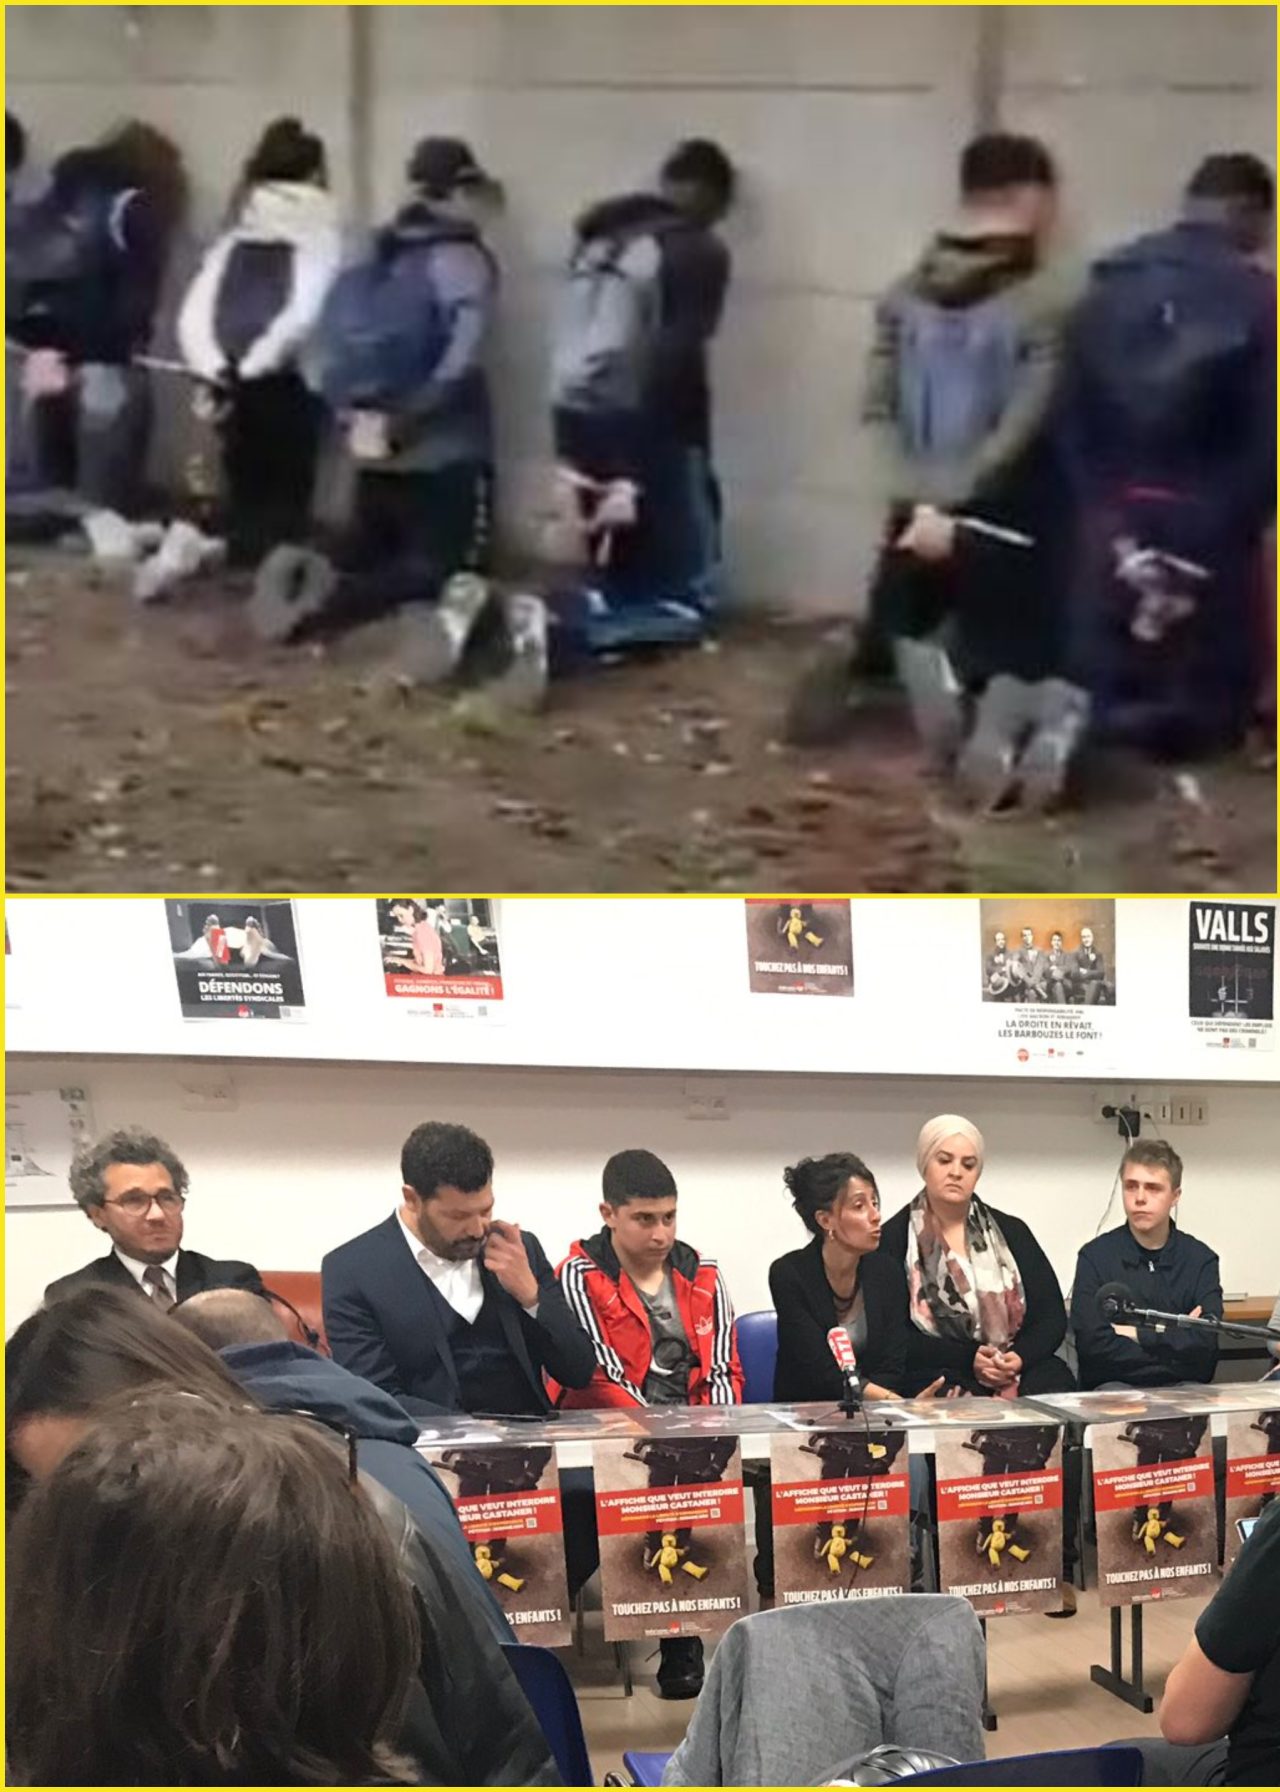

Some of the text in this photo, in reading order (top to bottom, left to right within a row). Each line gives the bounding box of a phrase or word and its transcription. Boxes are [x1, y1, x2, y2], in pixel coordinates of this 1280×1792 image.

[1195, 908, 1268, 944] VALLS
[784, 962, 796, 973] PAS
[797, 961, 802, 973] À
[198, 978, 283, 994] DÉFENDONS
[394, 984, 444, 994] GAGNONS
[445, 984, 489, 996] L'ÉGALITÉ
[213, 994, 242, 1002] LIBERTÉS
[1005, 1020, 1016, 1028] LA
[1018, 1020, 1048, 1029] DROITE
[1050, 1021, 1061, 1029] EN
[998, 1030, 1013, 1038] LES
[1014, 1030, 1064, 1039] BARBOUZES
[1065, 1031, 1074, 1039] LE
[1076, 1031, 1098, 1040] FONT
[1097, 1462, 1210, 1486] L'AFFICHE QUE VEUT INTERDIRE
[1229, 1462, 1265, 1473] L'AFFICHE
[1265, 1461, 1280, 1469] QUE
[1245, 1468, 1280, 1479] MONSIEUR
[940, 1475, 1059, 1495] L'AFFICHE QUE VEUT INTERDIRE
[1114, 1481, 1154, 1491] MONSIEUR
[1155, 1474, 1192, 1485] CASTANER
[600, 1487, 739, 1507] L'AFFICHE QUE VEUT INTERDIRE
[775, 1487, 819, 1498] L'AFFICHE
[819, 1485, 837, 1495] QUE
[838, 1484, 860, 1492] VEUT
[958, 1490, 999, 1501] MONSIEUR
[1000, 1485, 1040, 1497] CASTANER
[458, 1496, 556, 1514] QUE VEUT INTERDIRE
[621, 1502, 669, 1514] MONSIEUR
[670, 1498, 717, 1509] CASTANER
[794, 1494, 839, 1505] MONSIEUR
[482, 1508, 532, 1520] CASTANER
[1105, 1571, 1138, 1584] TOUCHEZ
[1139, 1569, 1153, 1581] PAS
[1154, 1566, 1160, 1579] À
[1160, 1567, 1175, 1579] NOS
[1175, 1563, 1207, 1577] ENFANTS
[783, 1590, 820, 1604] TOUCHEZ
[821, 1589, 837, 1601] PAS
[838, 1587, 844, 1601] À
[863, 1586, 898, 1598] ENFANTS
[948, 1584, 982, 1597] TOUCHEZ
[982, 1583, 997, 1595] PAS
[997, 1580, 1004, 1593] À
[1004, 1580, 1019, 1592] NOS
[1020, 1578, 1052, 1591] ENFANTS
[612, 1602, 652, 1616] TOUCHEZ
[653, 1601, 670, 1613] PAS
[671, 1598, 678, 1613] À
[679, 1600, 697, 1612] NOS
[697, 1597, 735, 1611] ENFANTS
[515, 1609, 556, 1625] ENFANTS
[557, 1608, 561, 1621] !
